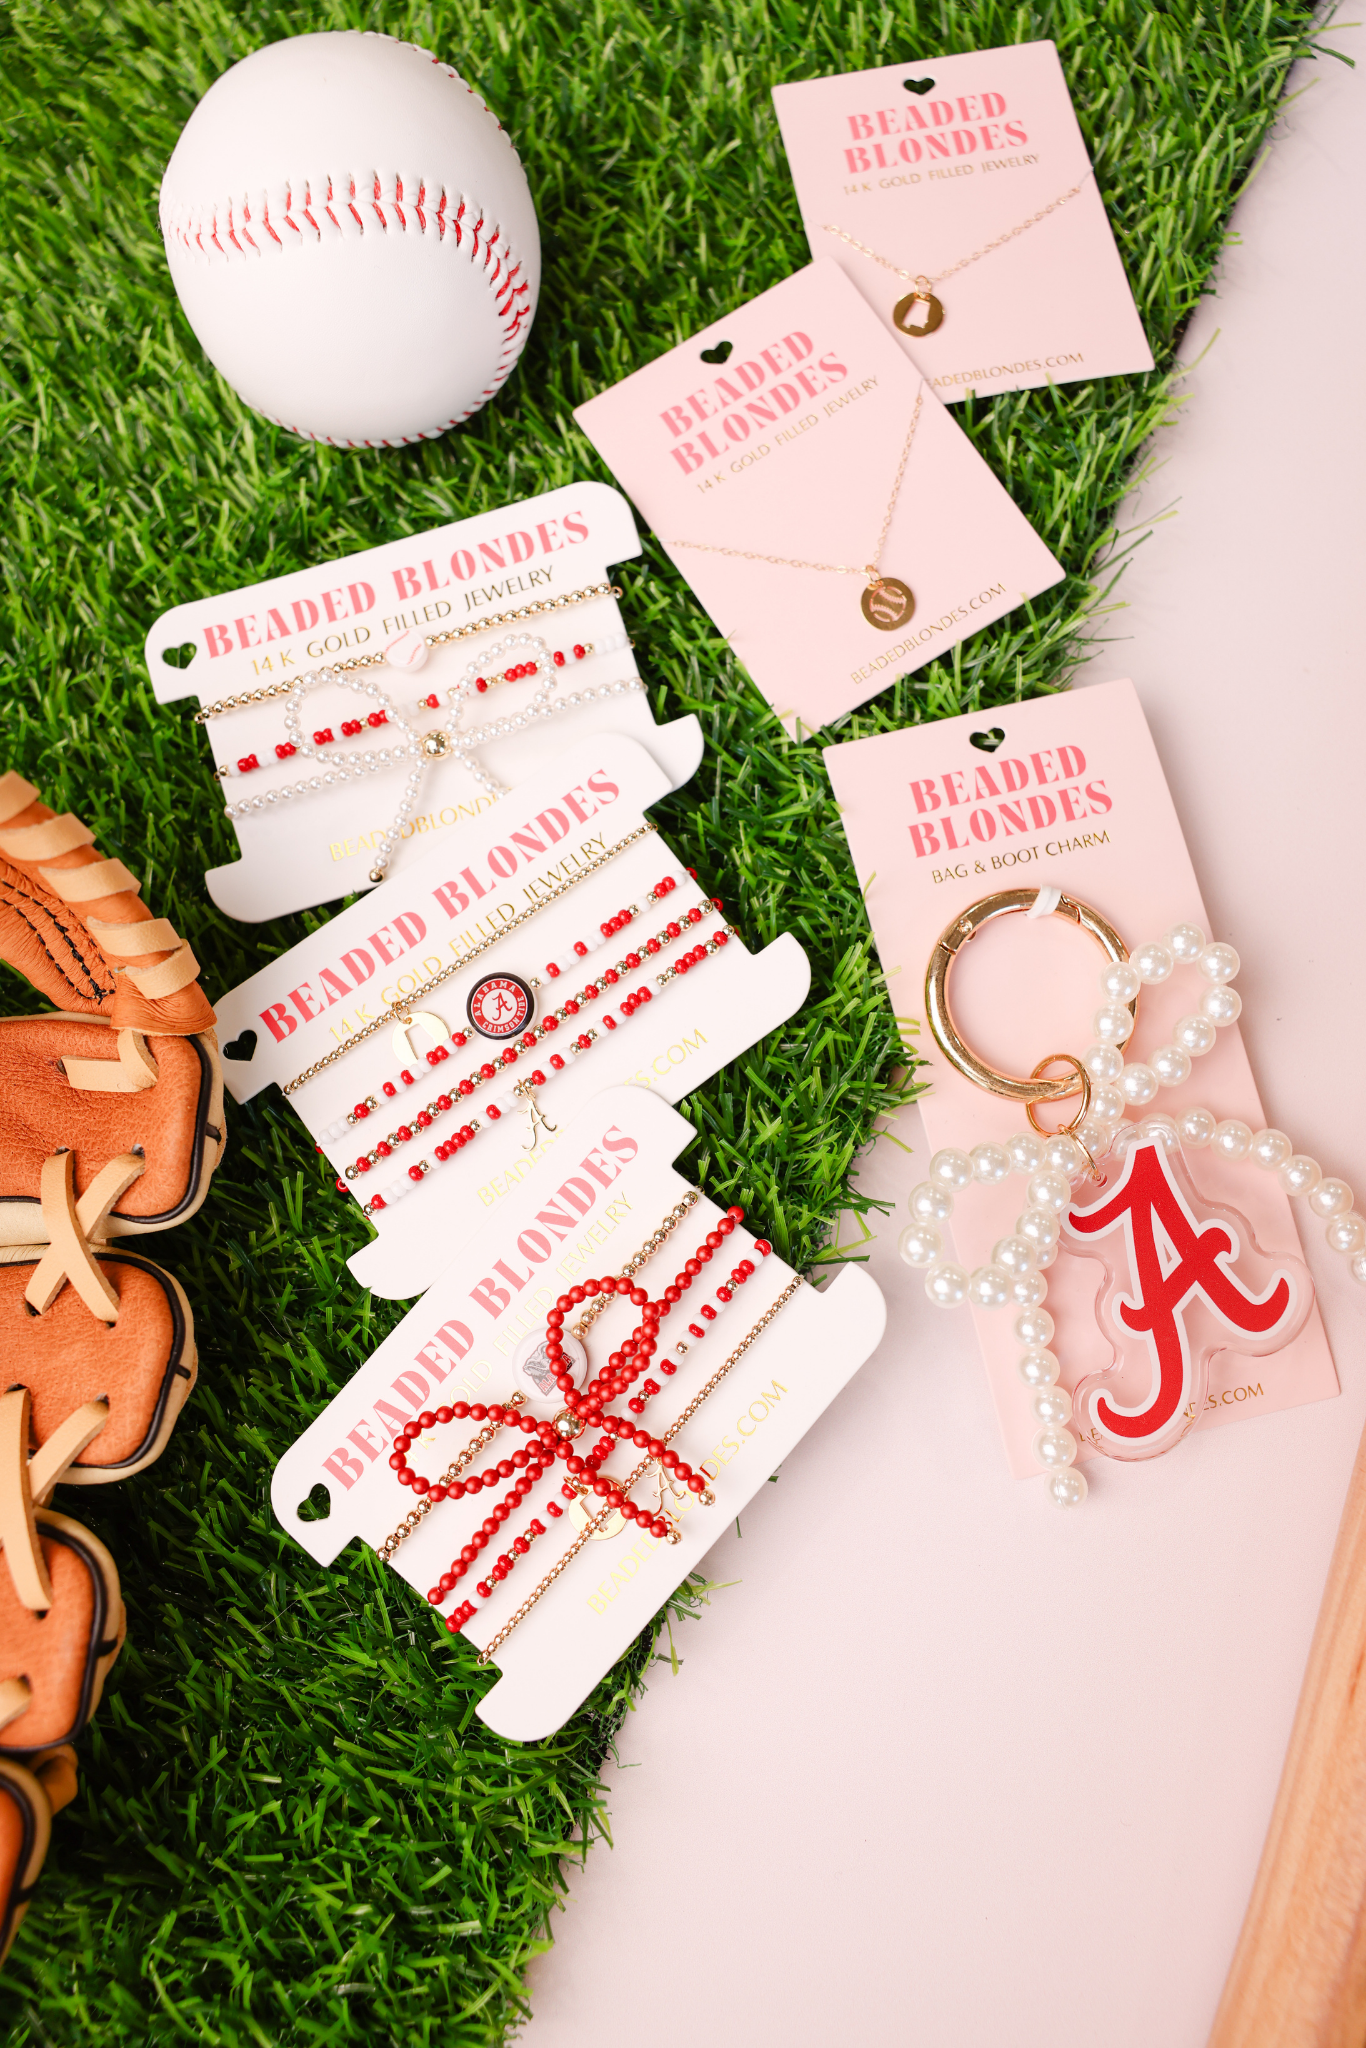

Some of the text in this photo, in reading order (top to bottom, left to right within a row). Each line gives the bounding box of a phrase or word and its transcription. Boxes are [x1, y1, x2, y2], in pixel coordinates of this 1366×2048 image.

[843, 120, 1028, 174] BLONDES
[847, 92, 1007, 141] BEADED
[879, 173, 921, 190] GOLD
[929, 164, 974, 181] FILLED
[981, 153, 1040, 175] JEWELRY
[659, 330, 815, 438] BEADED
[670, 351, 849, 476] BLONDES
[730, 443, 770, 475] GOLD
[774, 413, 819, 448] FILLED
[823, 376, 880, 418] JEWELRY
[202, 510, 590, 659] BEADED BLONDES
[306, 626, 371, 660] GOLD
[382, 600, 452, 634] FILLED
[463, 565, 555, 612] JEWELRY
[850, 582, 1007, 685] BEADEDBLONDES.COM
[907, 779, 1112, 859] BLONDES
[908, 744, 1087, 815] BEADED
[258, 769, 620, 1043] BEADED BLONDES
[931, 830, 1111, 885] BAG & BOOT CHARM
[380, 956, 442, 1006] GOLD
[449, 902, 515, 958] FILLED
[522, 832, 607, 904] JEWELRY
[474, 981, 516, 1016] ALABAMA
[482, 996, 526, 1033] CRIMSON TIDE
[492, 992, 513, 1021] A
[320, 1124, 639, 1492] BEADED BLONDES
[493, 1286, 555, 1357] FILLED
[556, 1192, 634, 1286] JEWELRY
[1069, 1145, 1292, 1440] A
